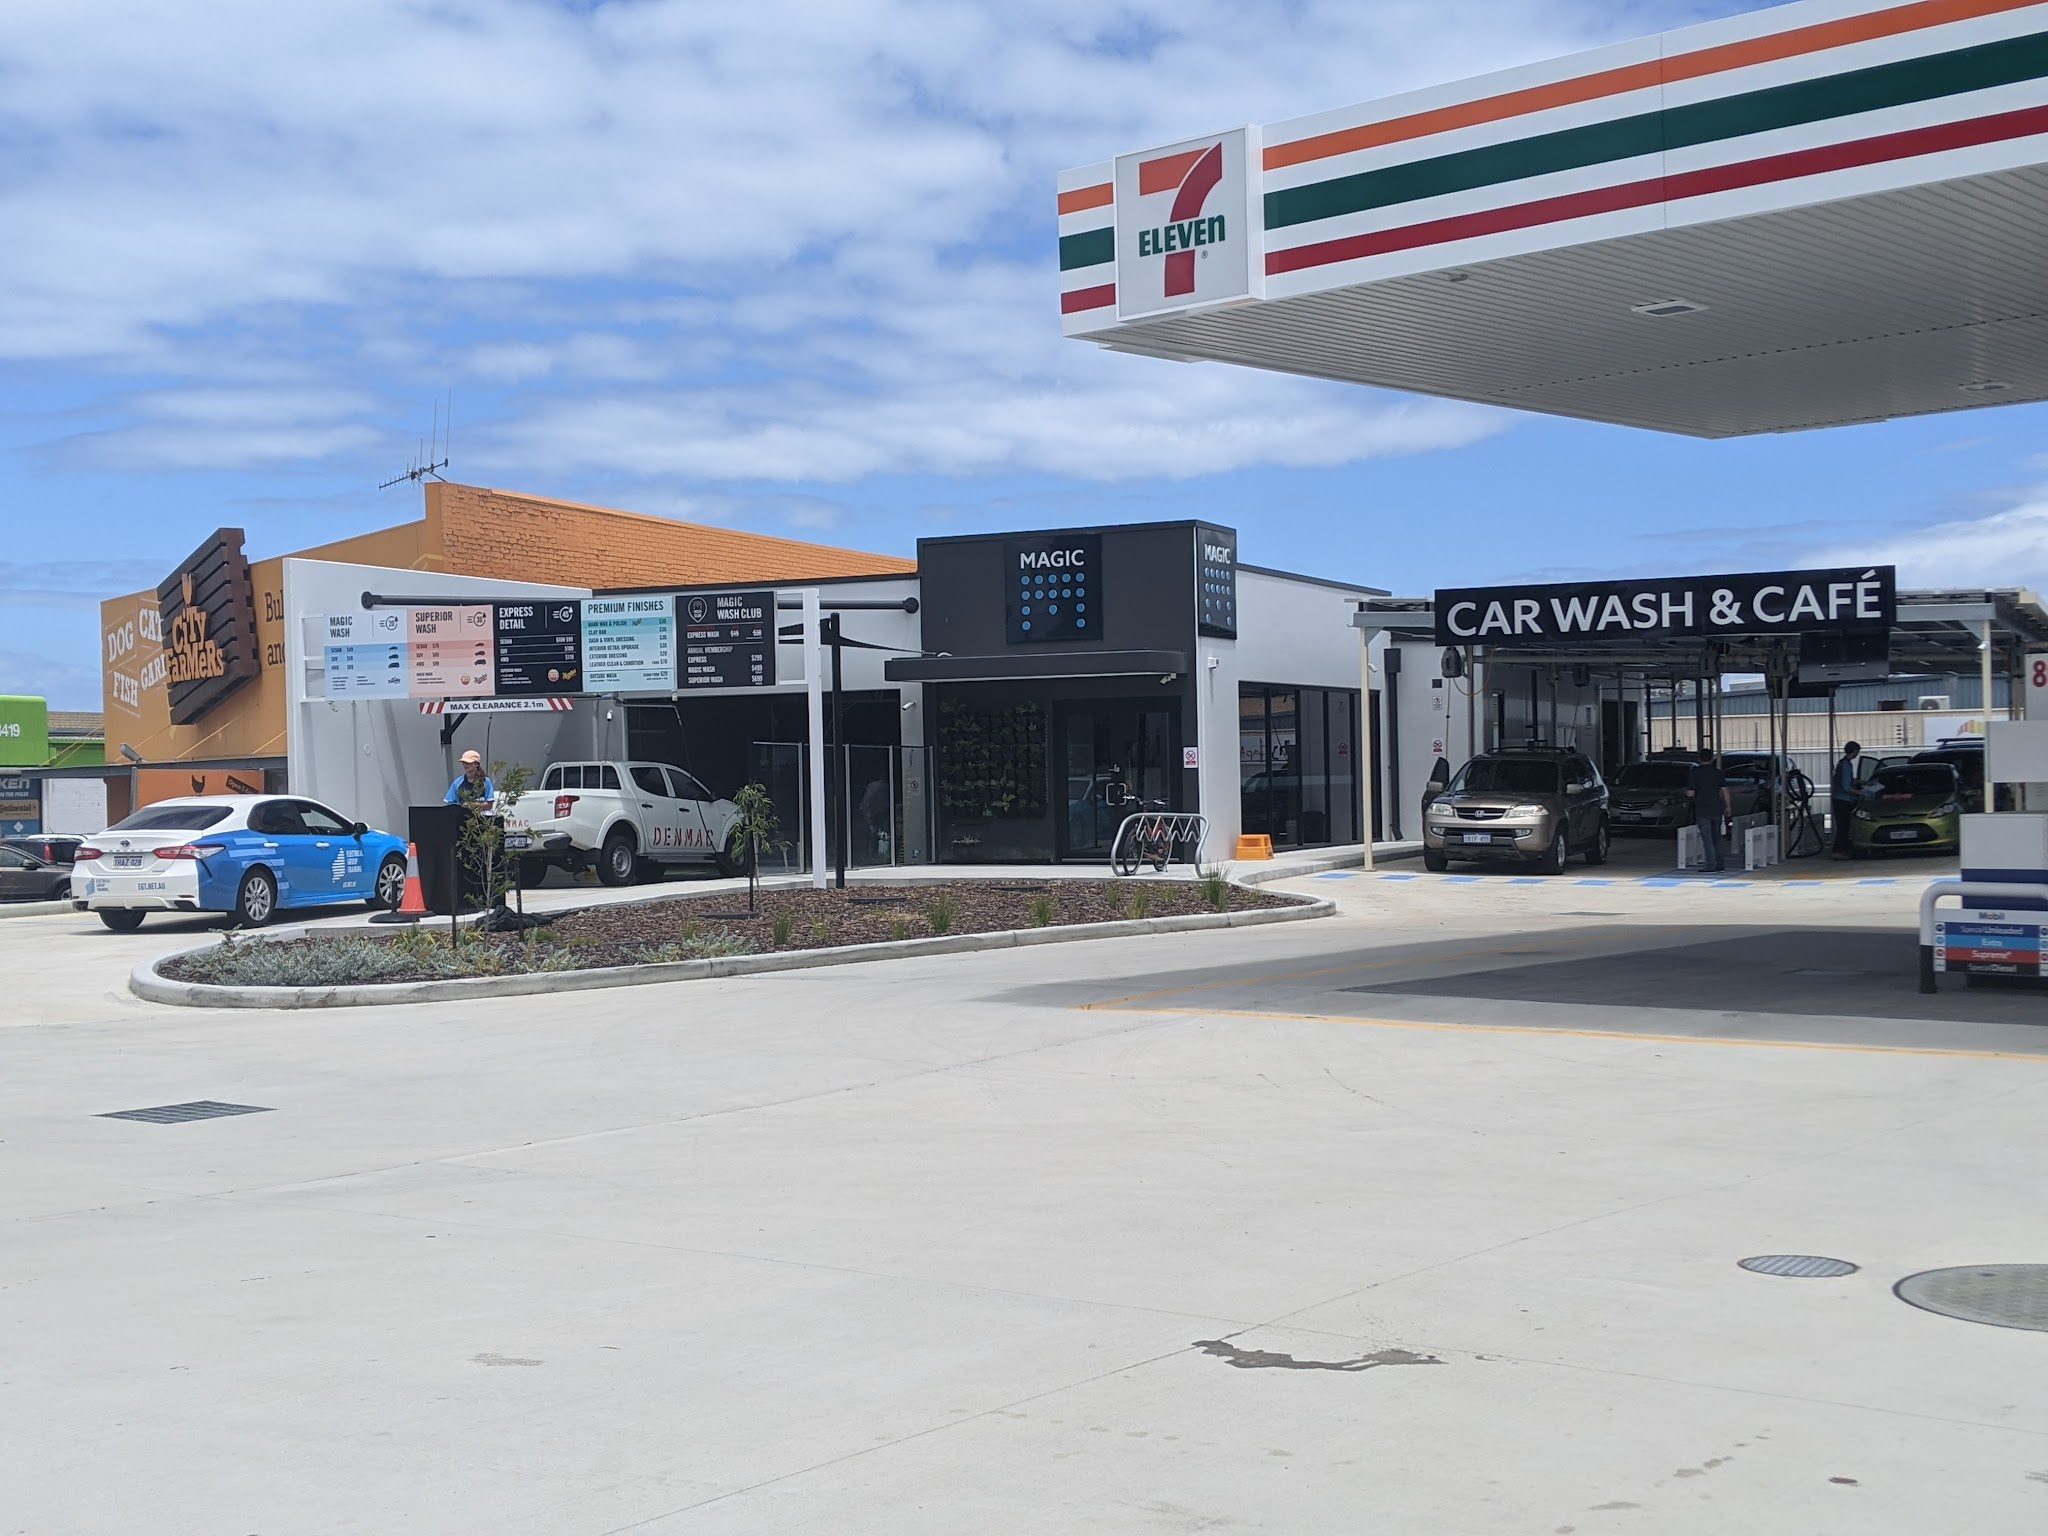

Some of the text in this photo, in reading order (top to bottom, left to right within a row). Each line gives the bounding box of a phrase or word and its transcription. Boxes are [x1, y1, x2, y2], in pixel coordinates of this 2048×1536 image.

[1138, 141, 1223, 298] 7
[1020, 549, 1085, 570] MAGIC
[1204, 543, 1231, 565] MAGIC
[587, 600, 664, 614] PREMIUM FINISHES
[716, 596, 743, 608] MAGIC
[1446, 569, 1882, 638] CAR WASH & CAFÉ
[415, 611, 453, 622] SUPERIOR
[499, 606, 534, 618] EXPRESS
[716, 607, 762, 620] WASH CLUB
[329, 616, 353, 627] MAGIC
[499, 618, 526, 630] DETAIL
[329, 627, 350, 638] WASH
[415, 623, 437, 634] WASH
[108, 621, 134, 663] DOG
[704, 645, 733, 653] MEMBERSHIP
[2032, 660, 2047, 688] 8
[113, 671, 139, 708] FISH
[450, 703, 470, 711] MAX
[653, 826, 714, 847] DENMAC
[1978, 912, 2005, 920] Mobil
[1981, 938, 2003, 947] Extra
